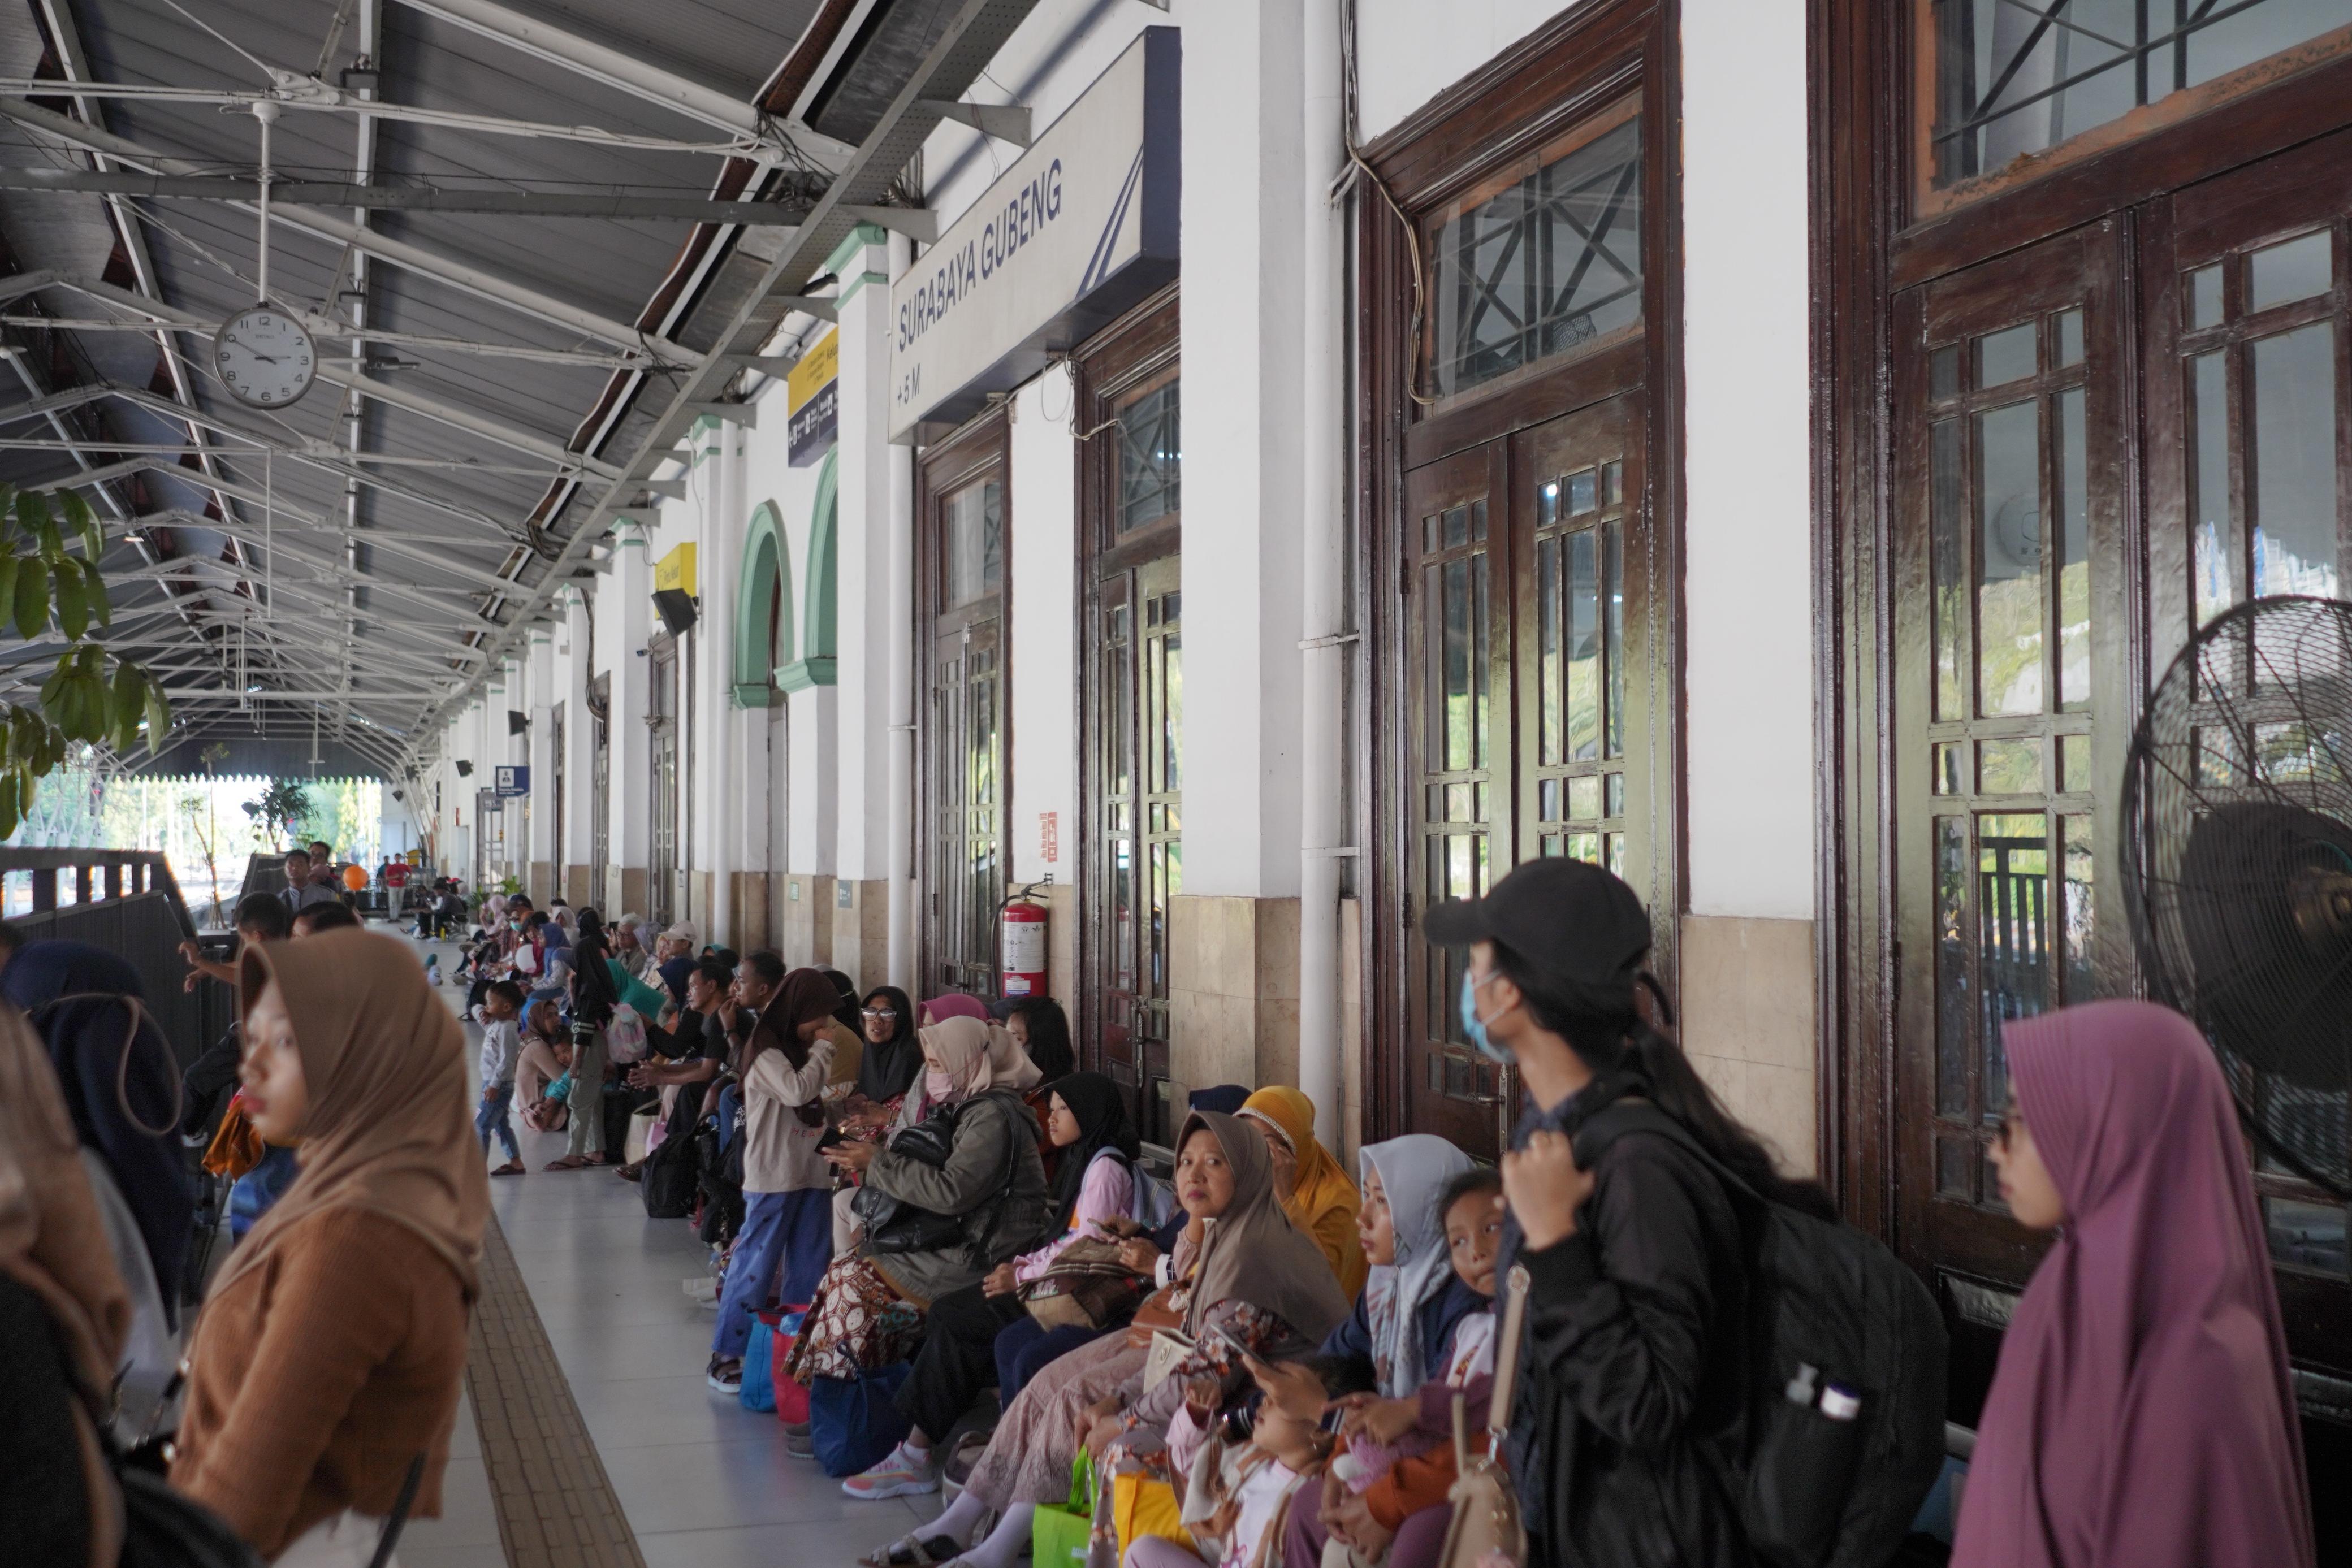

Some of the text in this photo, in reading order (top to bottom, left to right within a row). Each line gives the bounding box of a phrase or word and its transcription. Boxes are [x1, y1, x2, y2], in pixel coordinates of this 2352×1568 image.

[899, 158, 1062, 353] SURABAYA GUBENG
[241, 320, 248, 329] 11
[259, 316, 270, 326] 12
[224, 334, 236, 343] 10
[295, 337, 304, 346] 2
[220, 352, 231, 362] 9
[300, 356, 309, 366] 3
[227, 371, 236, 381] 8
[295, 374, 303, 383] 4
[241, 386, 249, 396] 7
[282, 387, 291, 397] 5
[261, 392, 271, 401] 6
